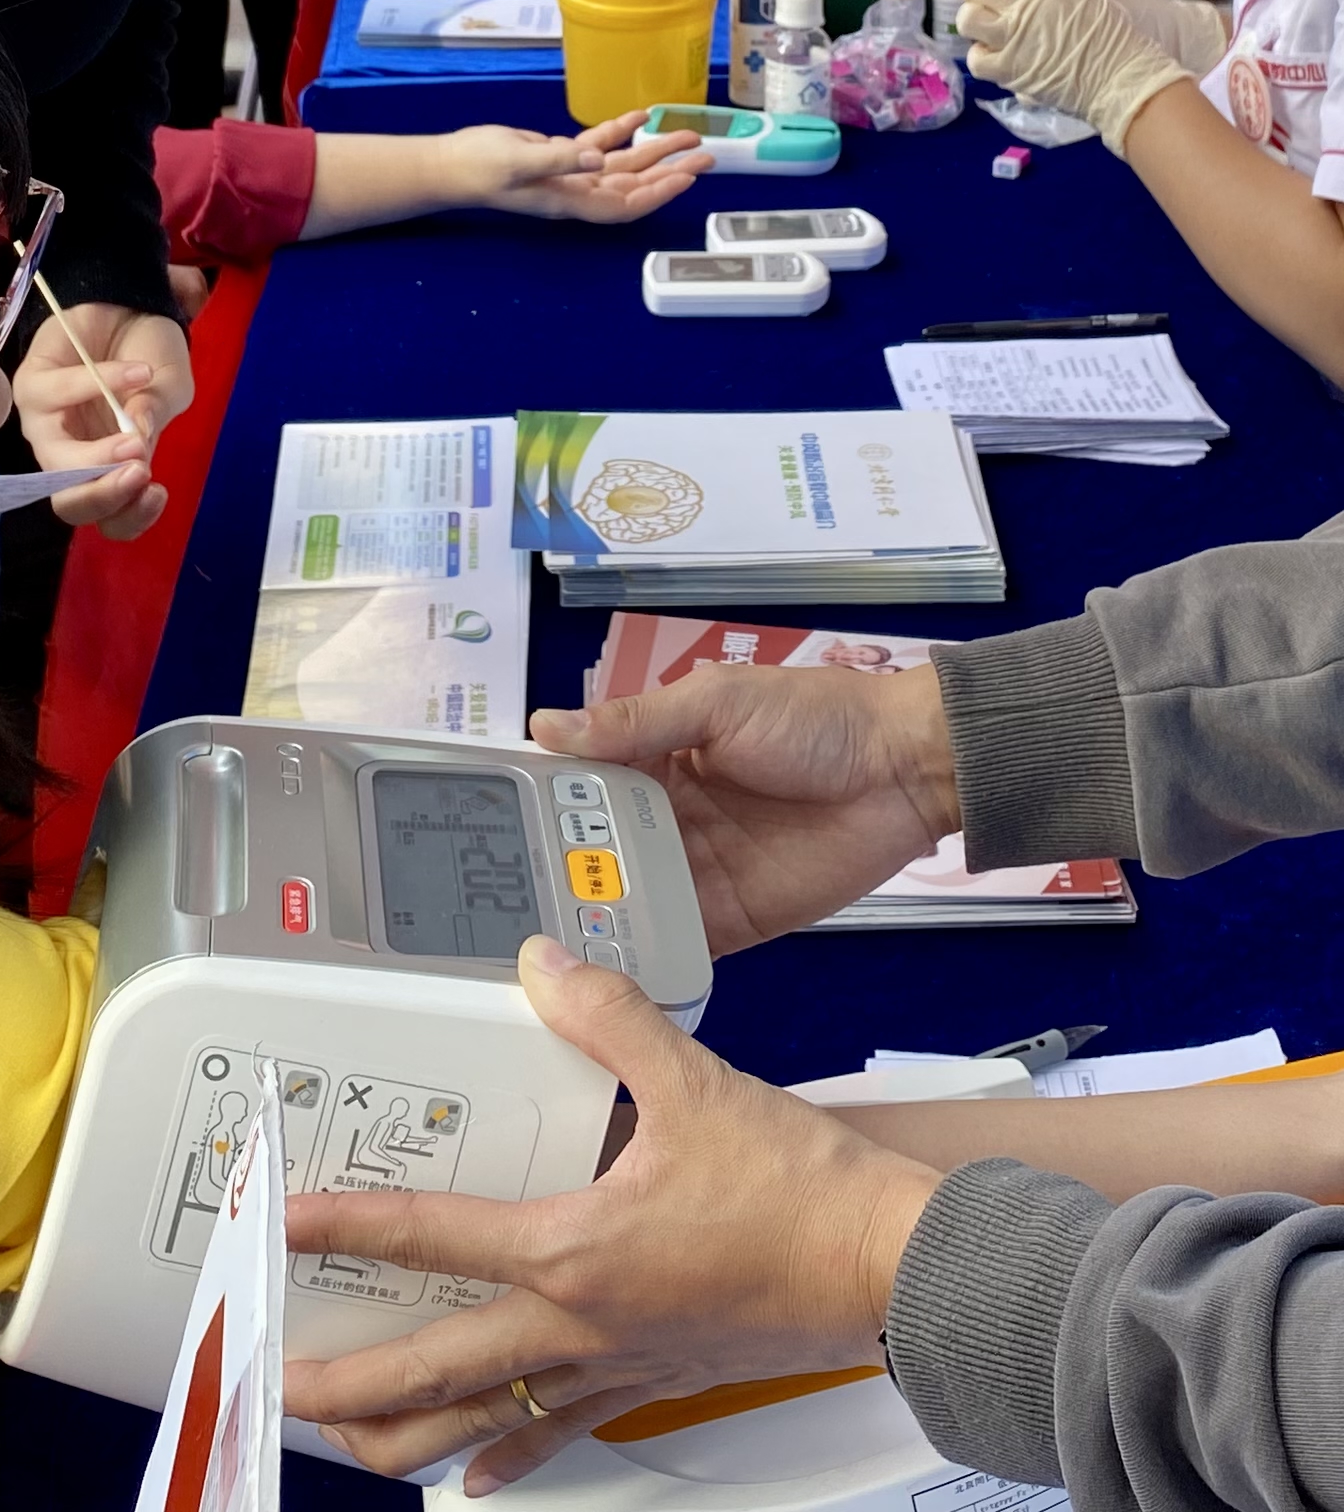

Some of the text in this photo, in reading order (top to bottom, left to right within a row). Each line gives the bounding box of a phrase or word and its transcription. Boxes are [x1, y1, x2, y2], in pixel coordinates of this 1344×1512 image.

[445, 682, 465, 734] 中国防治中
[309, 1275, 401, 1301] 血压计的位置偏近
